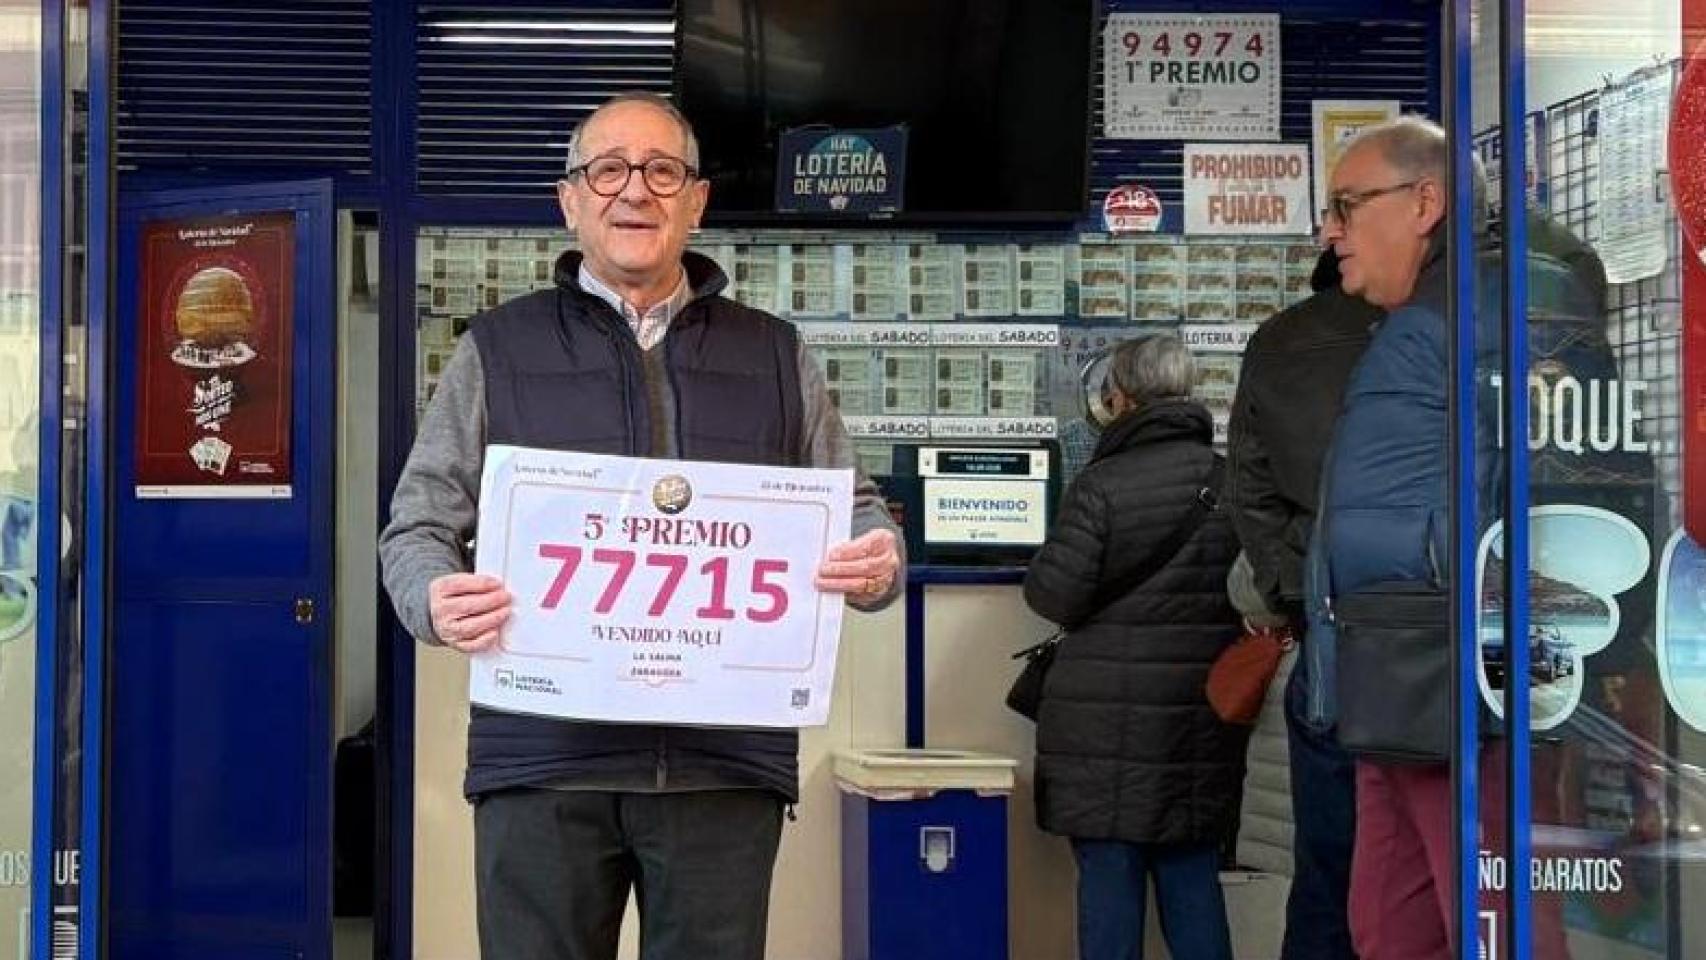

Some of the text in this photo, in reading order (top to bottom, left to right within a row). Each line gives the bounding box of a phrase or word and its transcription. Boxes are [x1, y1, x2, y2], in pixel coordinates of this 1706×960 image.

[1150, 61, 1261, 84] PREMIO
[831, 138, 854, 151] HAY
[796, 145, 886, 176] LOTERÍA
[1191, 153, 1302, 179] PROHIBIDO
[794, 178, 887, 194] DE NAVIDAD
[1208, 195, 1286, 225] FUMAR
[870, 330, 929, 343] SABADO
[999, 330, 1056, 343] SABADO
[997, 421, 1055, 435] SABADO
[938, 498, 1028, 512] BIENVENIDO
[622, 517, 752, 549] PREMIO
[539, 544, 789, 623] 77715
[592, 625, 671, 643] VENDIDO
[1530, 857, 1623, 891] BARATOS
